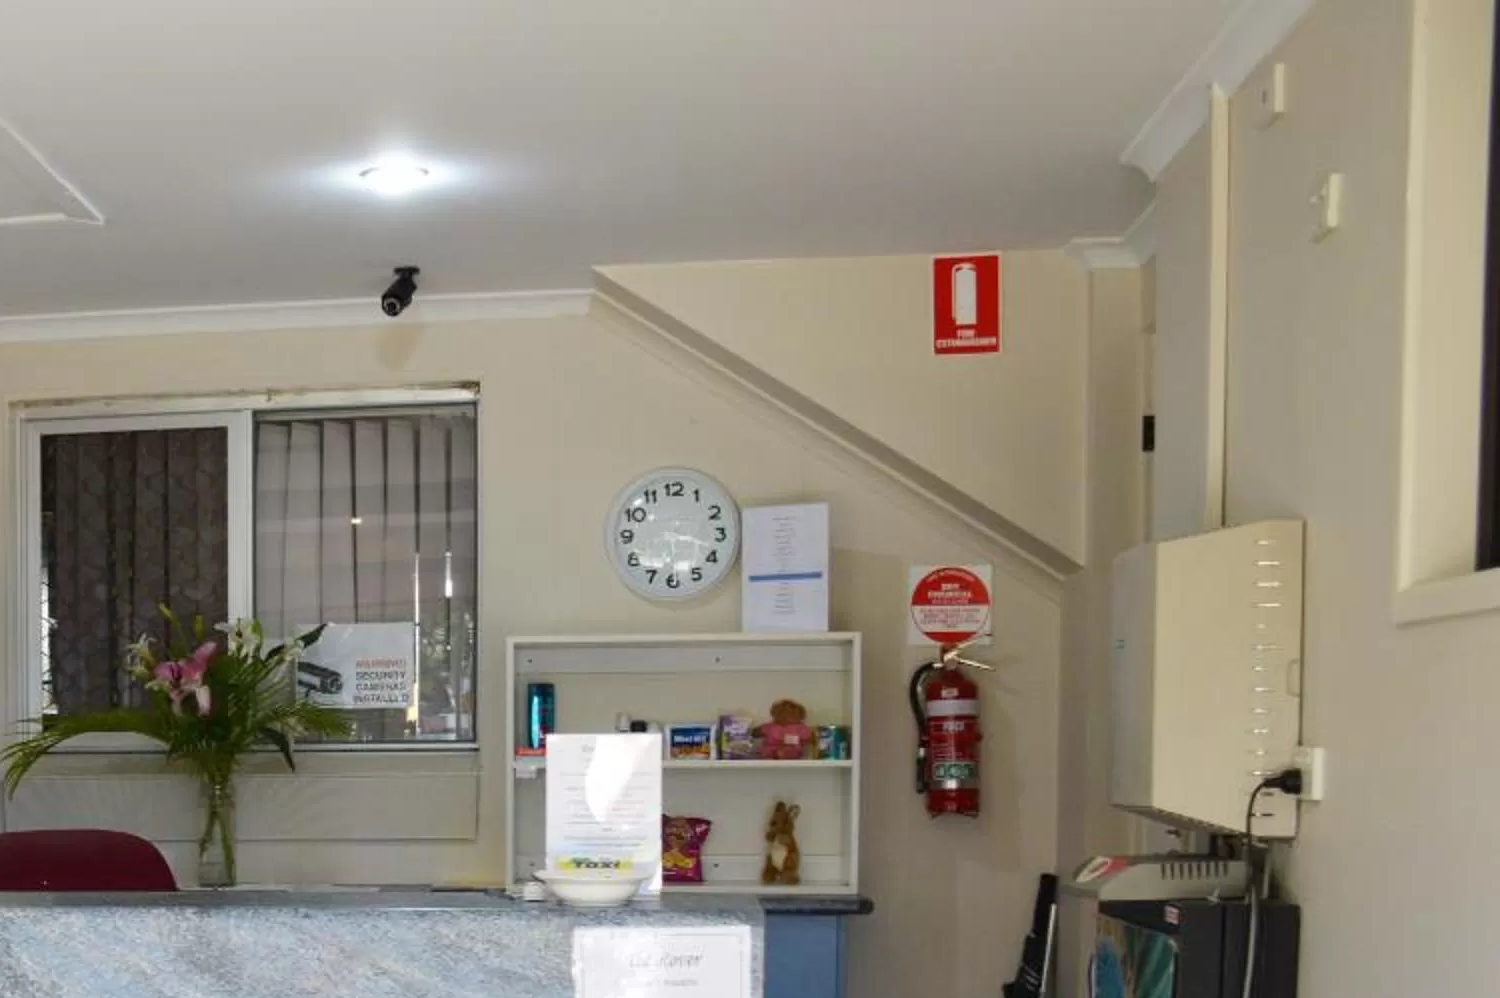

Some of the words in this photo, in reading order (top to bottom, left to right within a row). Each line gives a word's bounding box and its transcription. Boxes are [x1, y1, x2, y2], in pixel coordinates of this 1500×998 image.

[644, 489, 657, 503] 11
[664, 482, 684, 497] 12
[693, 489, 699, 502] 1
[624, 507, 647, 522] 10
[708, 505, 721, 520] 2
[620, 529, 634, 544] 9
[715, 527, 727, 542] 3
[627, 552, 640, 566] 8
[705, 550, 718, 563] 4
[645, 569, 657, 584] 7
[666, 574, 680, 588] 6
[691, 567, 702, 581] 5
[355, 671, 406, 681] SECURITY
